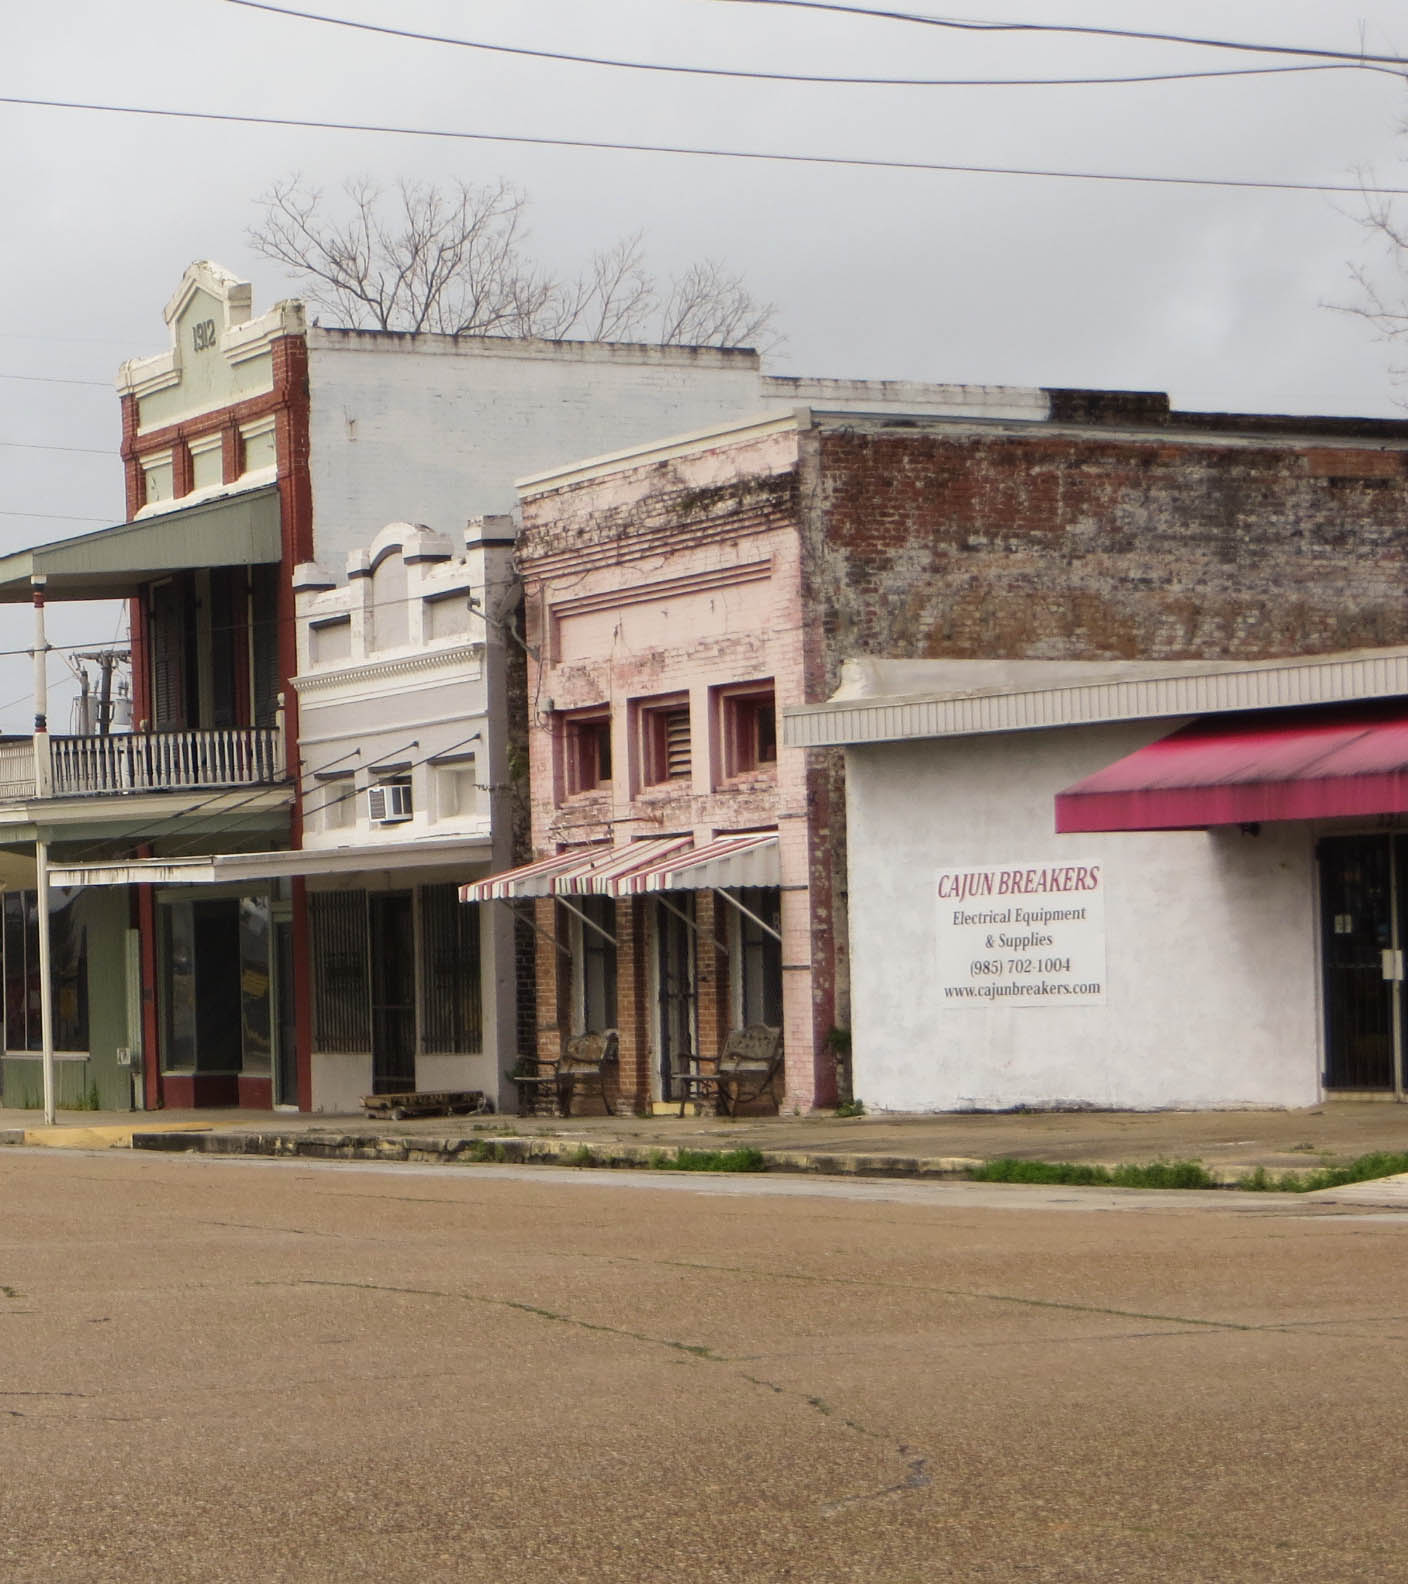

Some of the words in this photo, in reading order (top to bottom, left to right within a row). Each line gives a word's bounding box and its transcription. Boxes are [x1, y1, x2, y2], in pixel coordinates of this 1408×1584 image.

[192, 319, 216, 352] 1912
[938, 872, 995, 903] CAJUN
[997, 866, 1100, 895] BREAKERS
[953, 908, 1011, 926] Electrical
[1015, 907, 1086, 927] Equipment
[985, 934, 994, 949] &
[998, 932, 1053, 951] Supplies
[970, 960, 1003, 977] (985)
[1008, 958, 1071, 974] 702-1004
[944, 981, 1101, 1000] www.cajunbreakers.com
